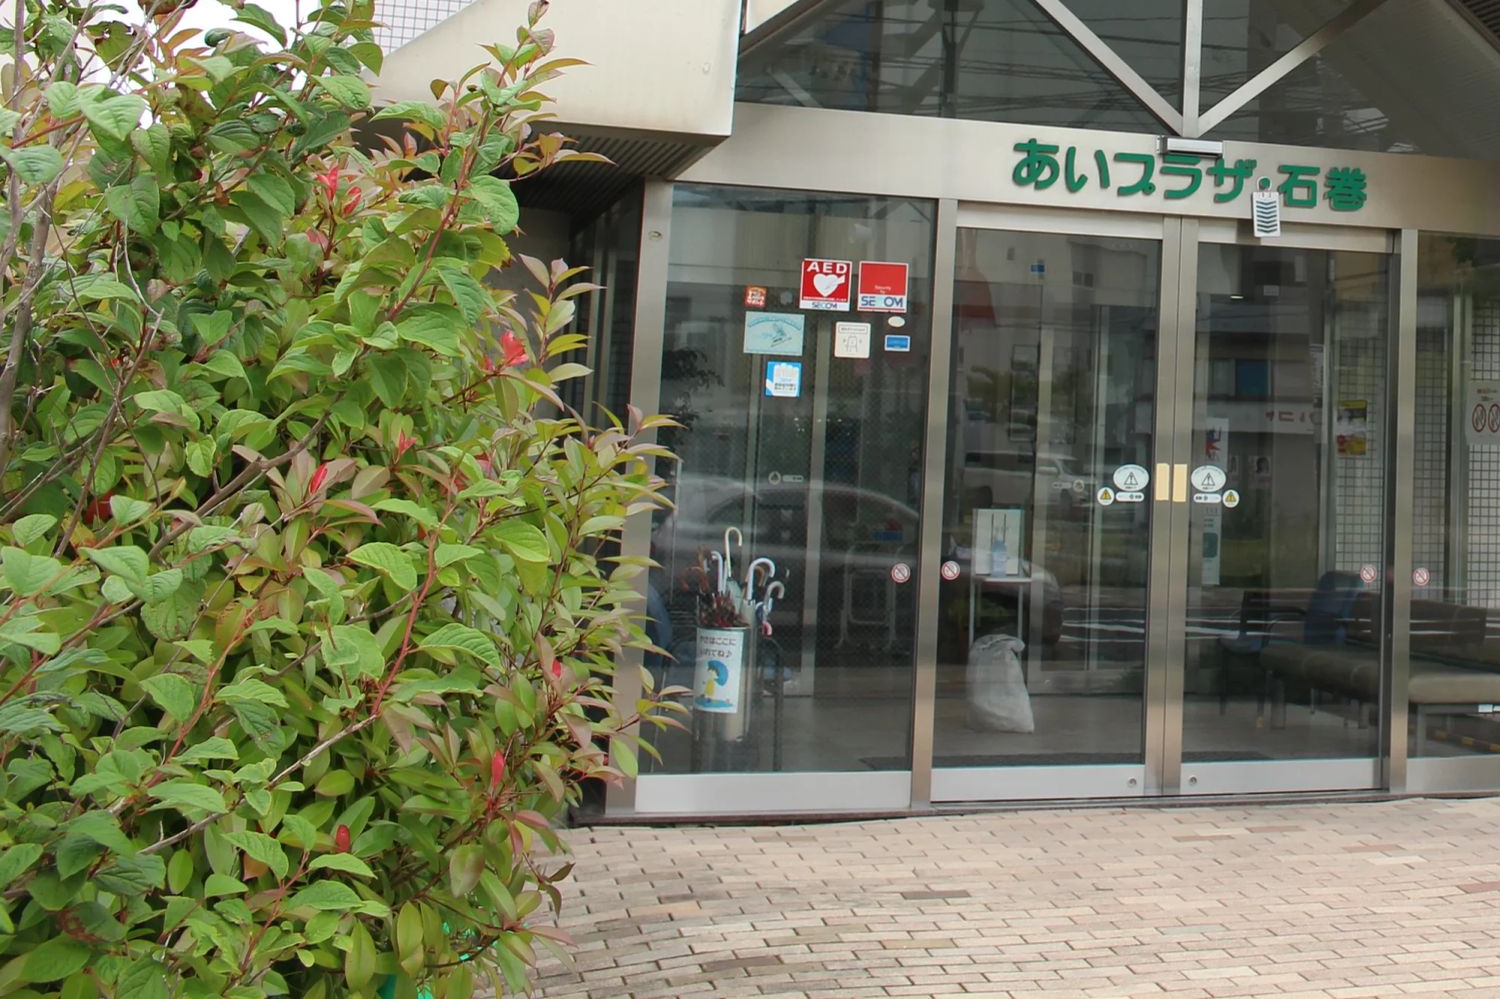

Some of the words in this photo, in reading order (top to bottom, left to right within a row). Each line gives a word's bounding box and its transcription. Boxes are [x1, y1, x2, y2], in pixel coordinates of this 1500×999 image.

[1012, 138, 1368, 211] あいプラザ・石巻
[807, 261, 847, 274] AED
